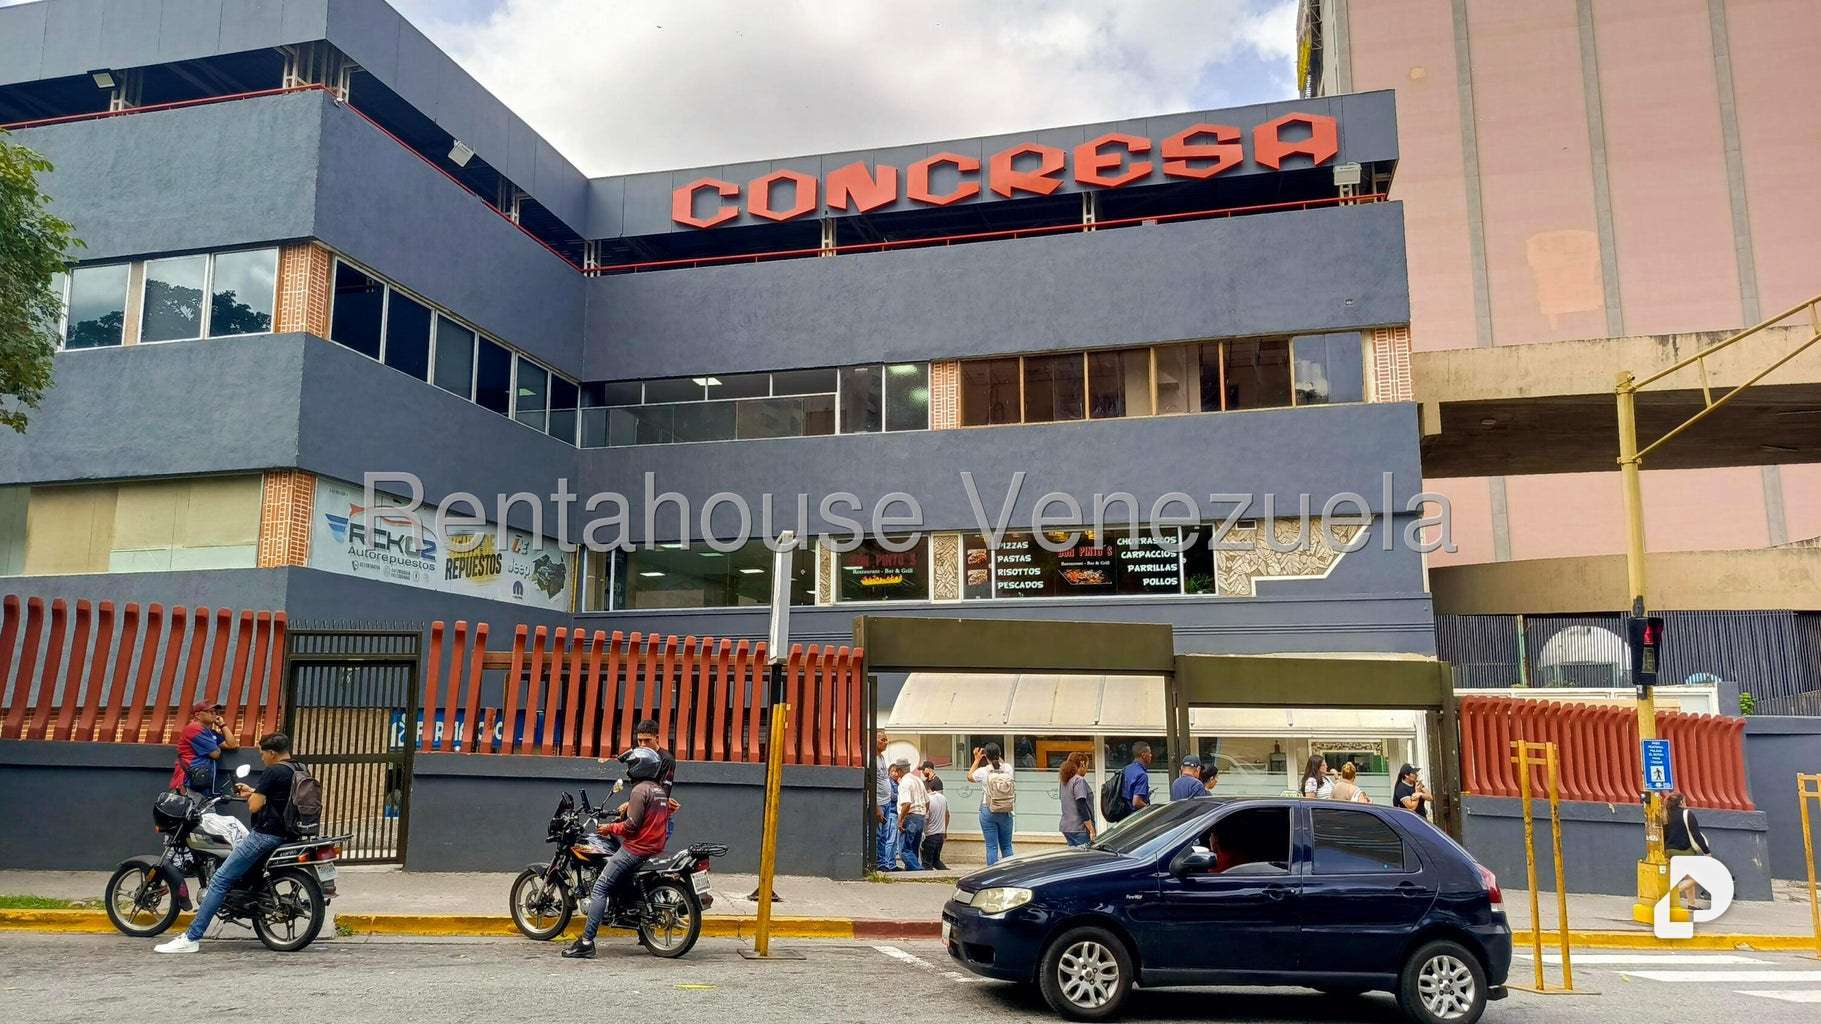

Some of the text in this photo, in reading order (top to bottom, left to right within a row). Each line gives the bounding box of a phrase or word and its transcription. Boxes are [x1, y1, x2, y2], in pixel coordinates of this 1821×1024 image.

[671, 111, 1339, 228] CONCRESA
[347, 546, 436, 571] Autorepuestos
[997, 554, 1032, 563] PASTAS
[1120, 551, 1178, 559] CARPACCIOS
[444, 553, 503, 580] REPUESTOS
[507, 557, 531, 579] Jeep
[1127, 564, 1178, 573] PARRILLAS
[997, 567, 1041, 576] RISOTTOS
[997, 581, 1044, 590] PESCADOS
[1142, 577, 1179, 586] POLLOS
